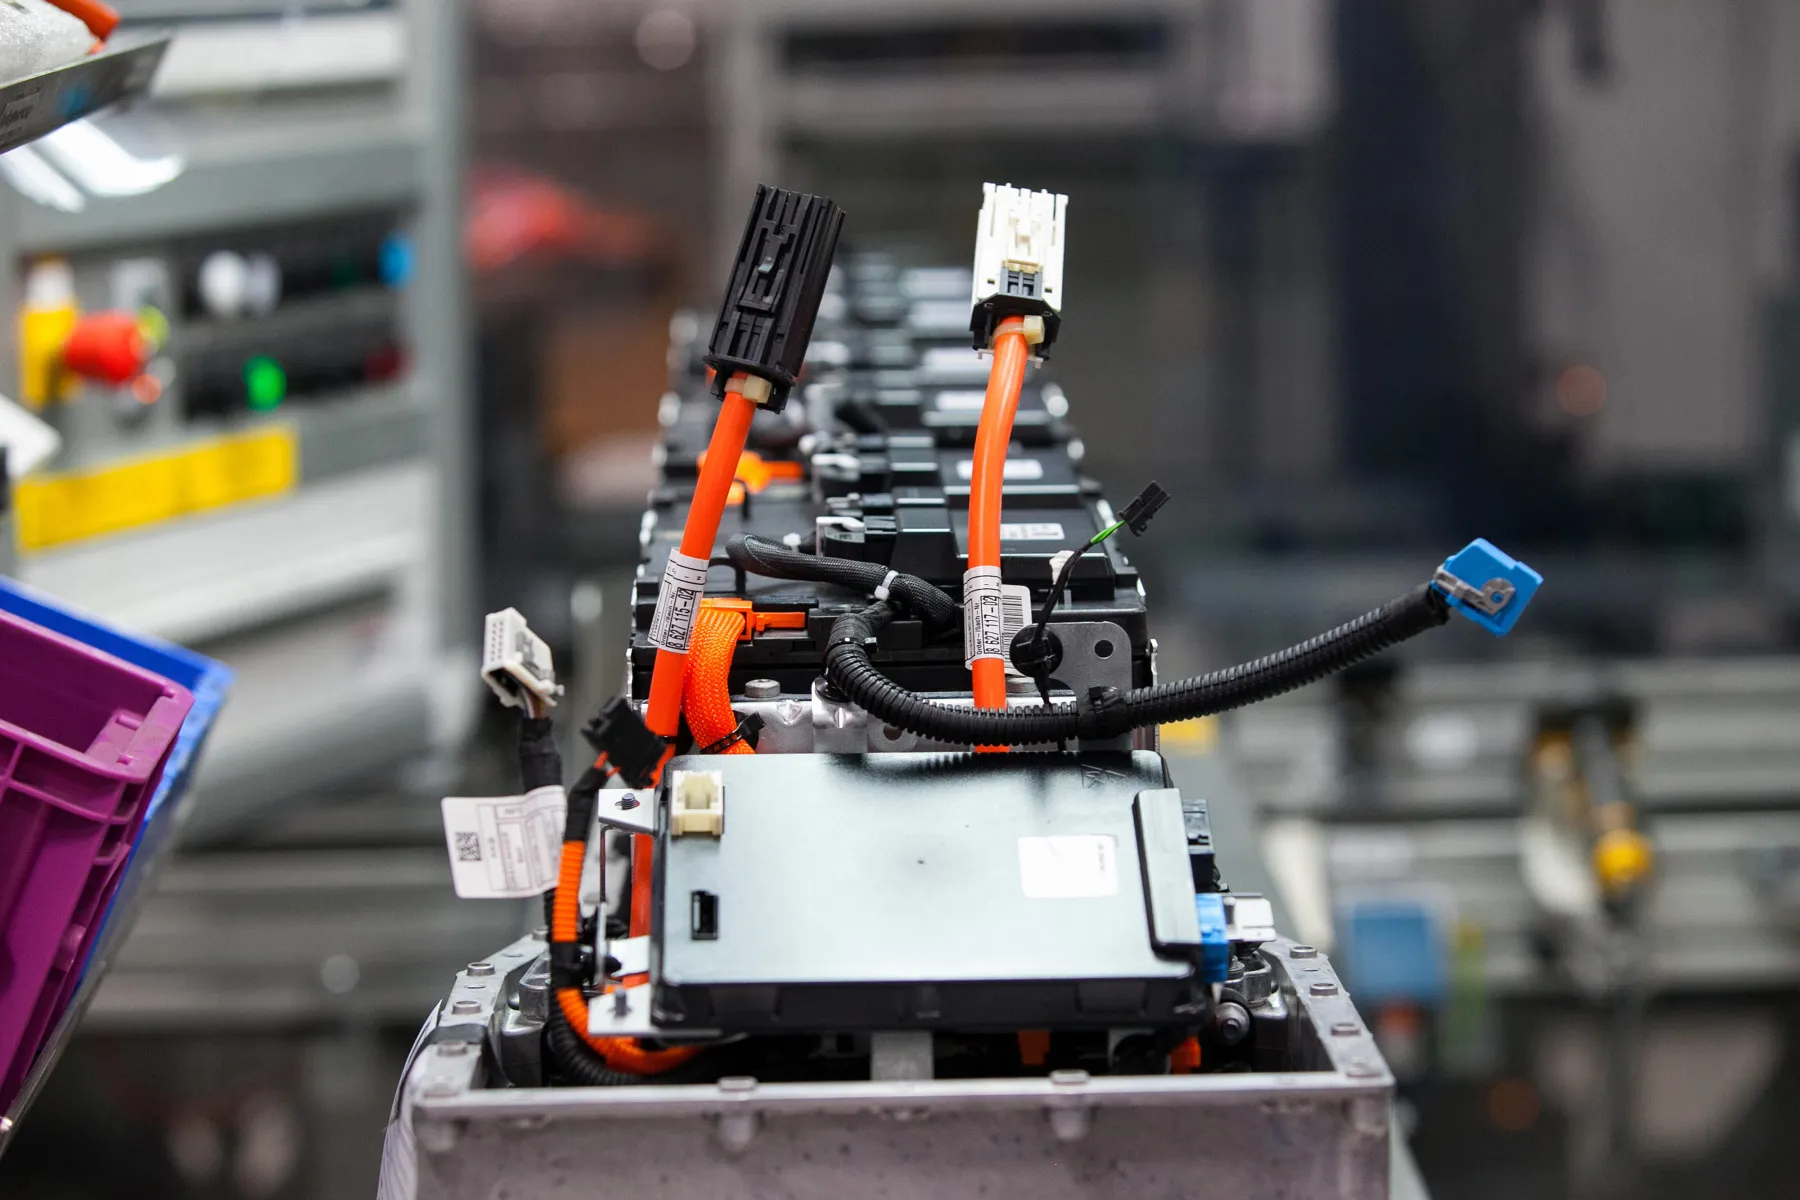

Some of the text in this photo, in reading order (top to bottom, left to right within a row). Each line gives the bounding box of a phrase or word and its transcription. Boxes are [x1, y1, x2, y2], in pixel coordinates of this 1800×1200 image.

[669, 624, 687, 640] 627
[985, 630, 1000, 645] 627
[668, 641, 683, 649] 8
